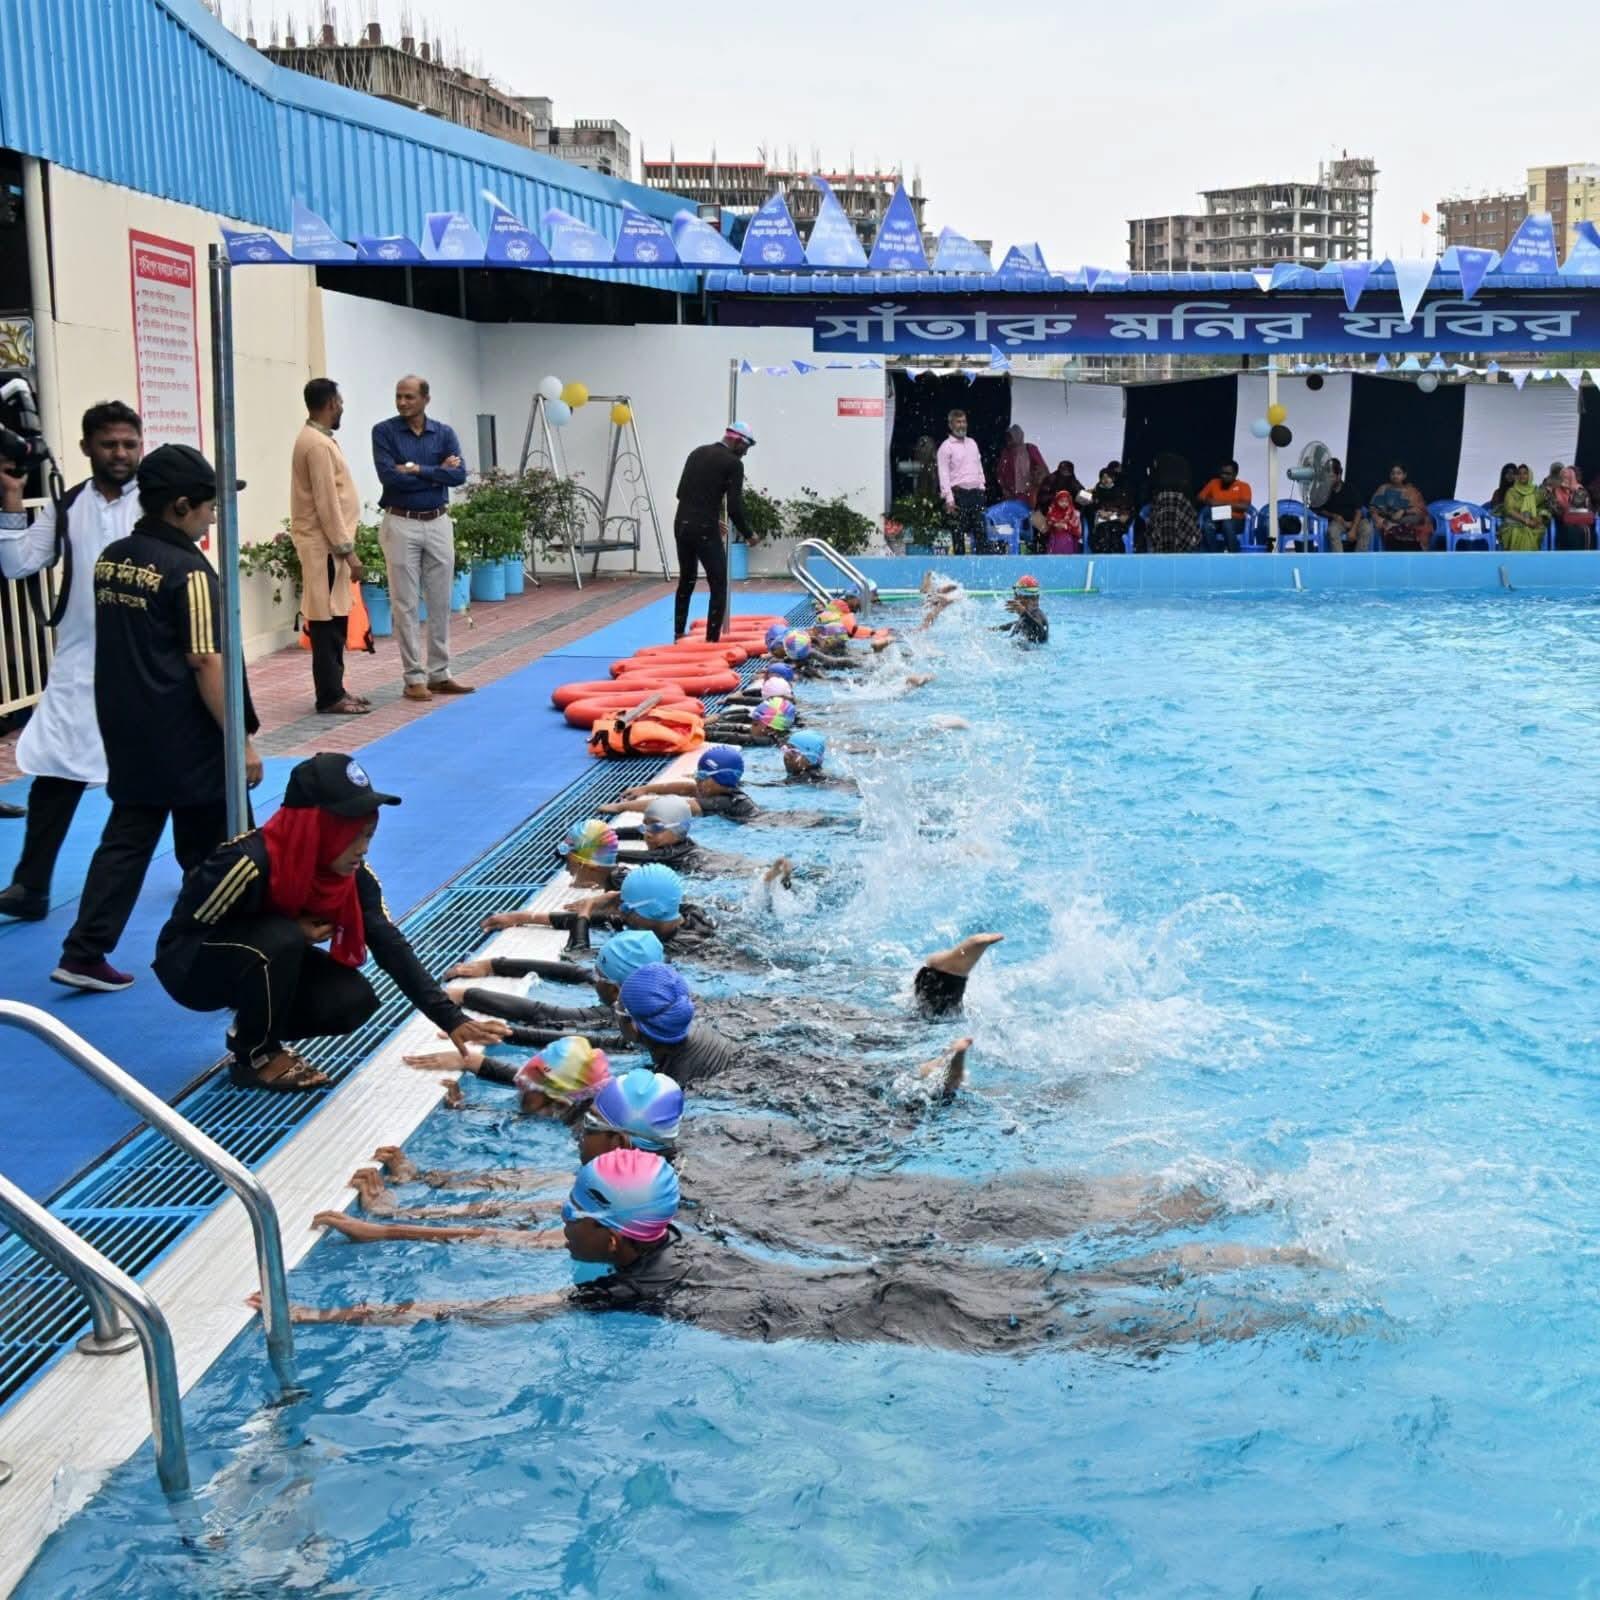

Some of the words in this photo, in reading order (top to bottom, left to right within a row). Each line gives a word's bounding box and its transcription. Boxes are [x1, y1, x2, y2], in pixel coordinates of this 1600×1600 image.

[816, 302, 1077, 345] সাঁতারু
[1105, 301, 1312, 345] মনির
[1338, 299, 1580, 341] ফকির
